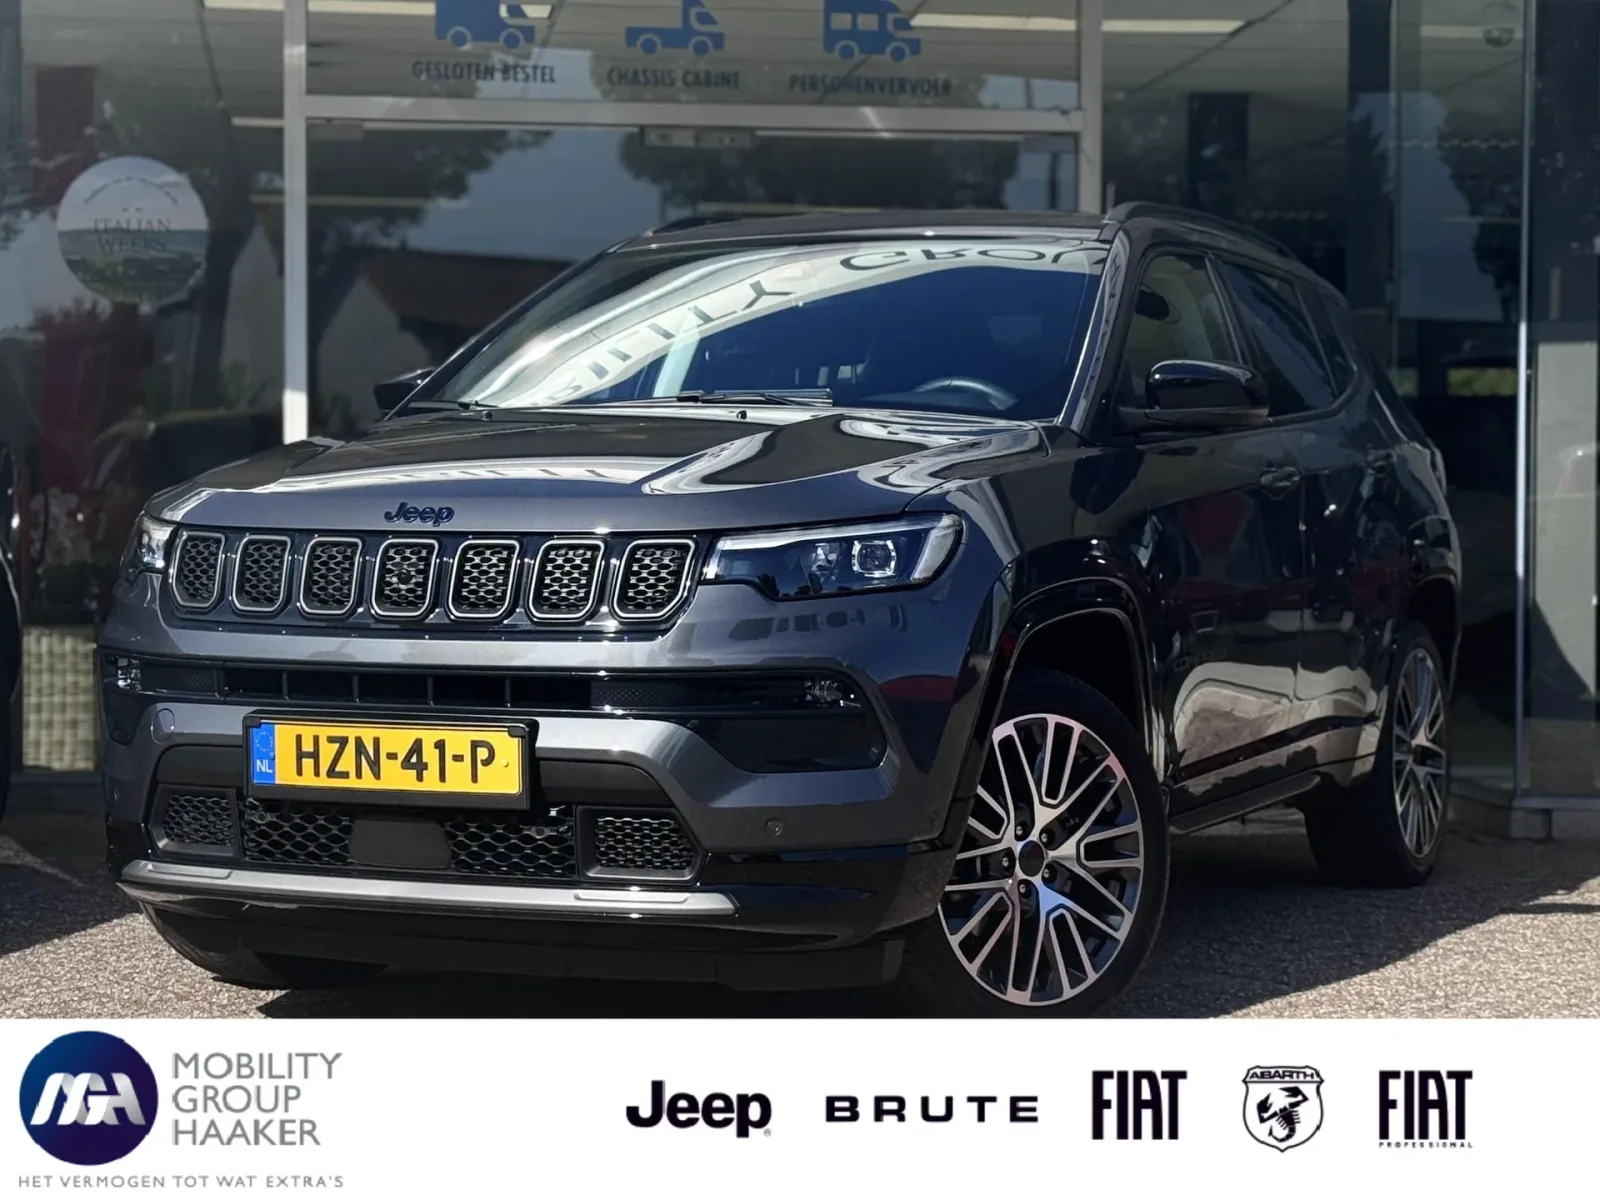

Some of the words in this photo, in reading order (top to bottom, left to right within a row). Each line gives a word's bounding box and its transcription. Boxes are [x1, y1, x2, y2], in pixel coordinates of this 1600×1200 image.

[412, 61, 495, 81] GESLOTEN
[501, 63, 556, 83] BESTEL
[607, 67, 676, 87] CHASSIS
[682, 69, 741, 89] CABINE
[384, 502, 454, 527] Jeep
[256, 759, 273, 774] NL
[295, 733, 496, 784] HZN-41-P
